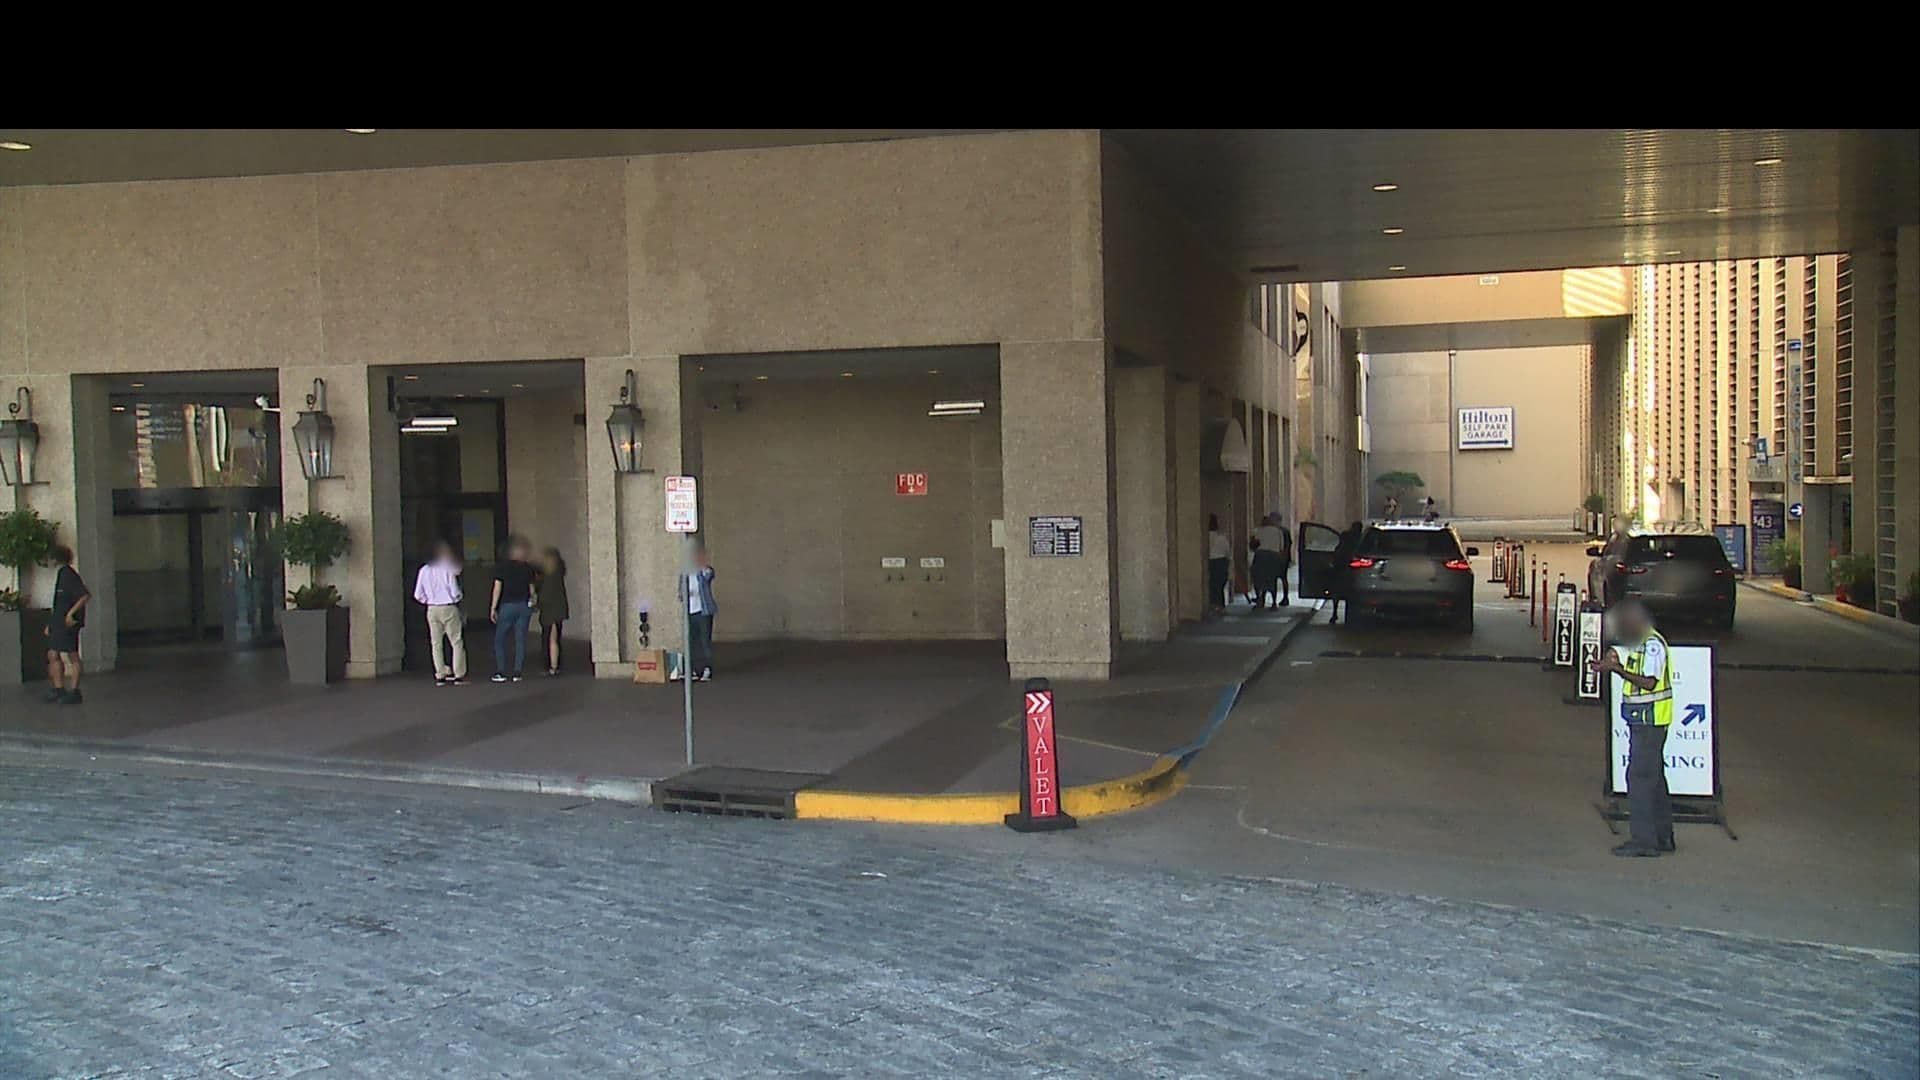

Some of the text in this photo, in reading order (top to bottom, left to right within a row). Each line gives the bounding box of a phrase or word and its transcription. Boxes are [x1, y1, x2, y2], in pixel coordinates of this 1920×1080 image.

[1462, 411, 1508, 423] Hilton
[900, 473, 924, 486] FDC
[1560, 620, 1569, 661] VALET
[1584, 645, 1596, 693] VALET
[1676, 730, 1708, 740] SELF
[1033, 716, 1051, 815] VALET
